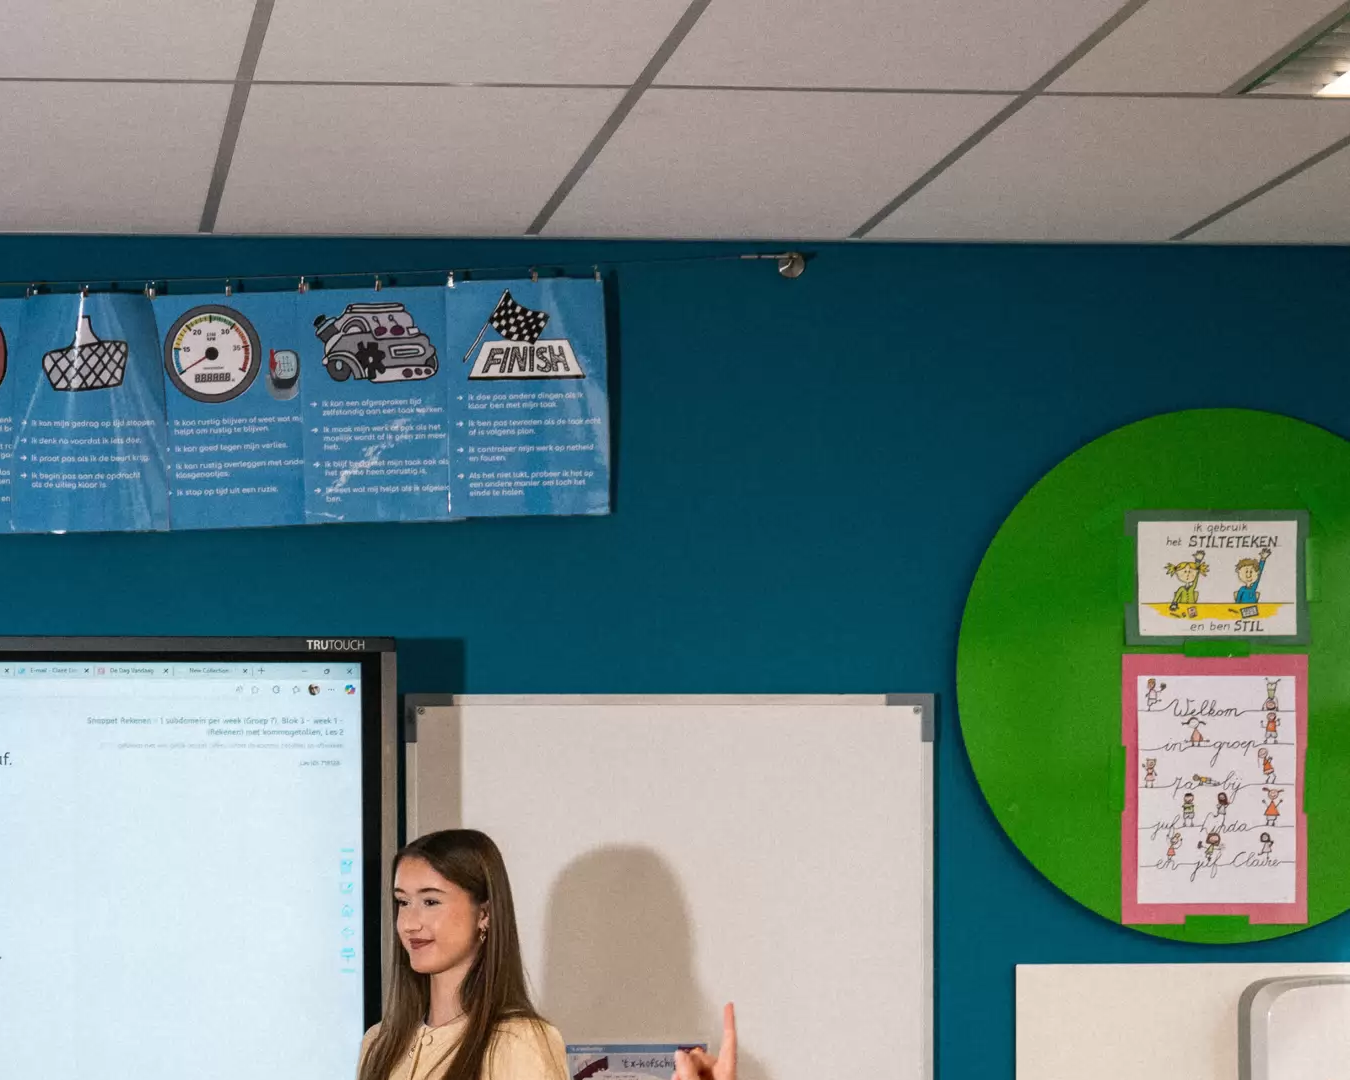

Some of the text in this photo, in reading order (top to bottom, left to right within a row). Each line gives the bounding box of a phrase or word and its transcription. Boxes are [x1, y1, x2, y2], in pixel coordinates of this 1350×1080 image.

[482, 344, 570, 374] FINISH
[220, 444, 242, 452] tegen
[244, 443, 260, 451] mijn
[1194, 523, 1248, 537] ik gebruik
[1166, 536, 1182, 546] het
[1209, 621, 1231, 631] ben
[1234, 621, 1264, 632] STIL
[306, 639, 365, 651] TRUTOUCH
[1171, 699, 1243, 717] Welkom
[1162, 738, 1258, 767] in groep
[1222, 770, 1243, 804] bij
[1155, 851, 1280, 882] en juf Claire
